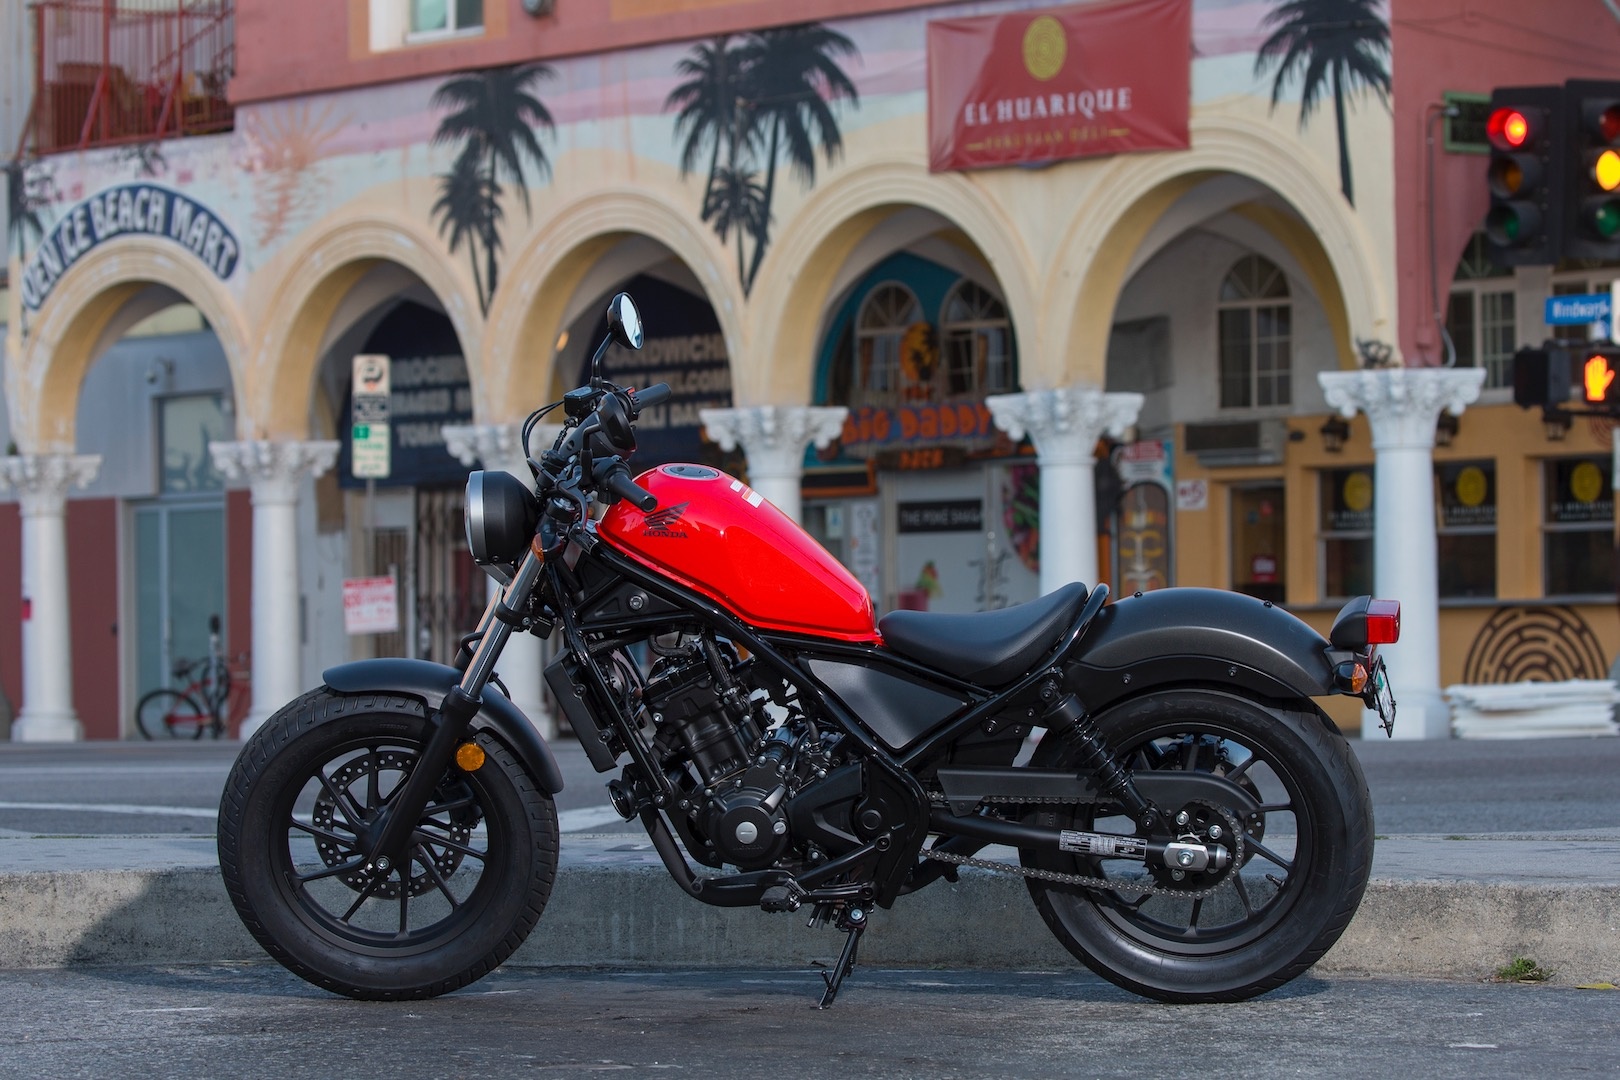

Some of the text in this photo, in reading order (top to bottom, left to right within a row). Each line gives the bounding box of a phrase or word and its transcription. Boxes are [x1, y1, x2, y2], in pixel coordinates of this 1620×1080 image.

[965, 87, 1131, 125] EL HUARIQUE
[89, 187, 165, 240] BEACH
[169, 195, 236, 278] MART
[643, 530, 688, 539] HONDA
